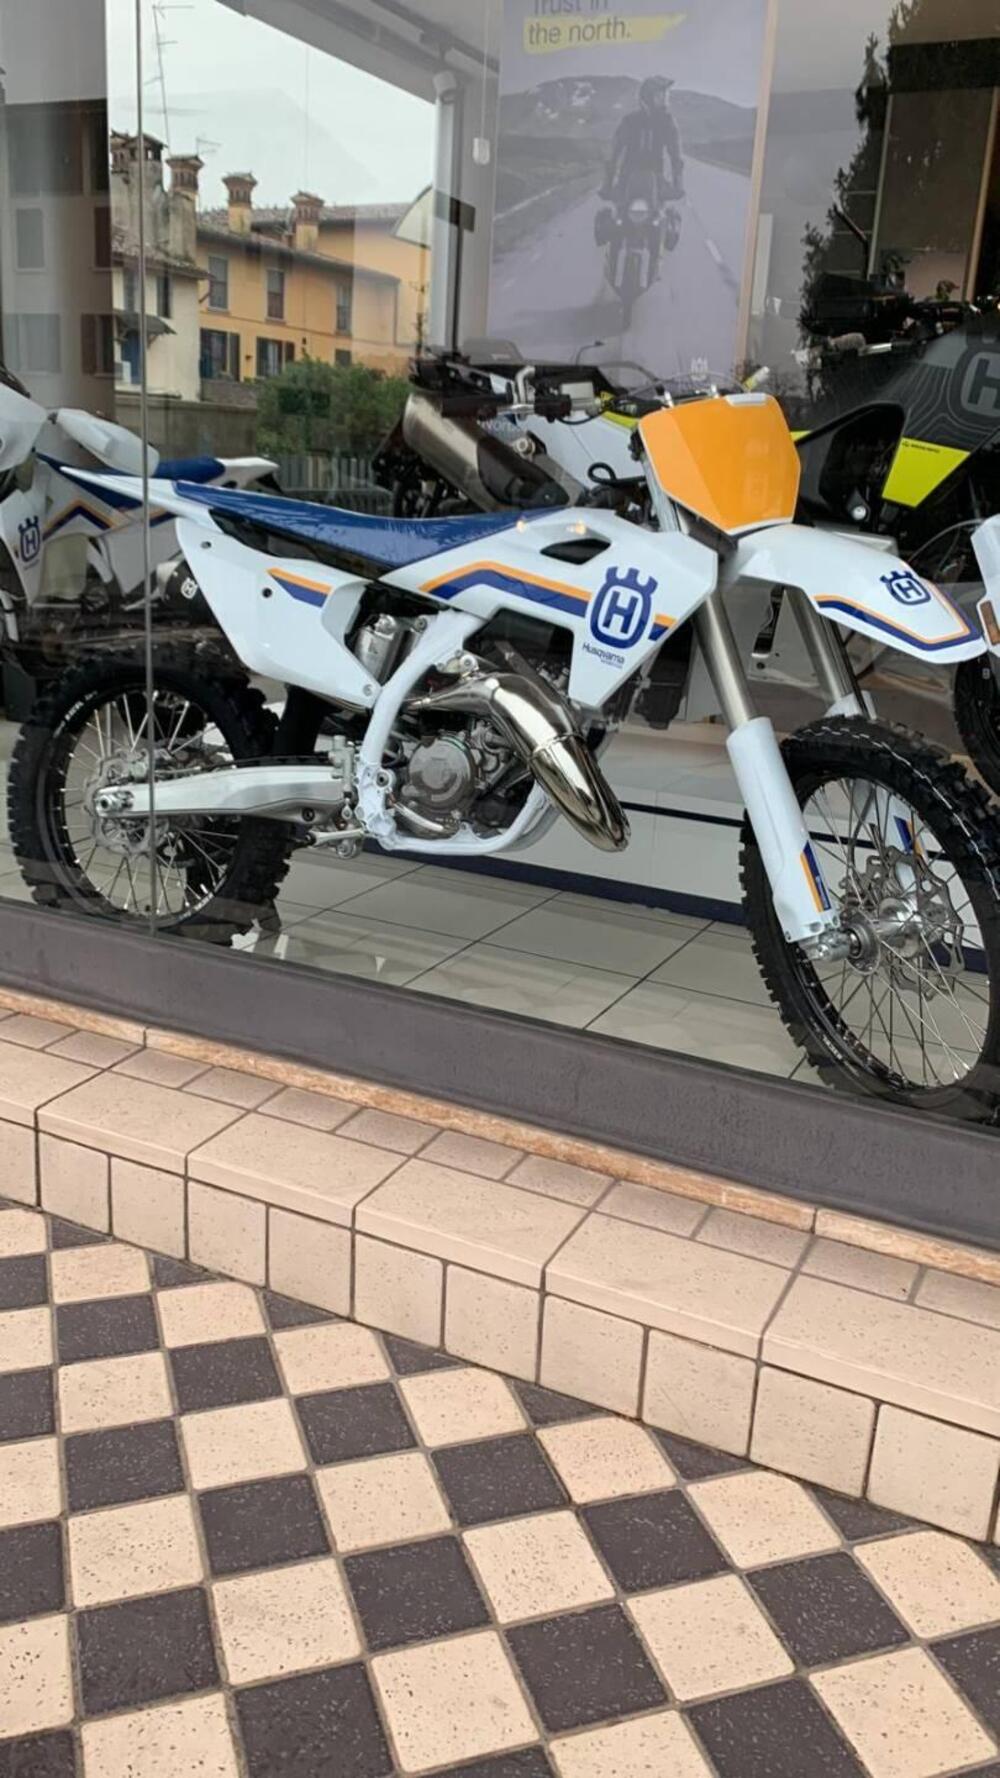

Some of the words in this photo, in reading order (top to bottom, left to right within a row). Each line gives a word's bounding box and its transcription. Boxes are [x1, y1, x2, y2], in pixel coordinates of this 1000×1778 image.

[528, 21, 561, 45] the
[568, 15, 631, 42] north.
[582, 642, 625, 664] Husqvarna
